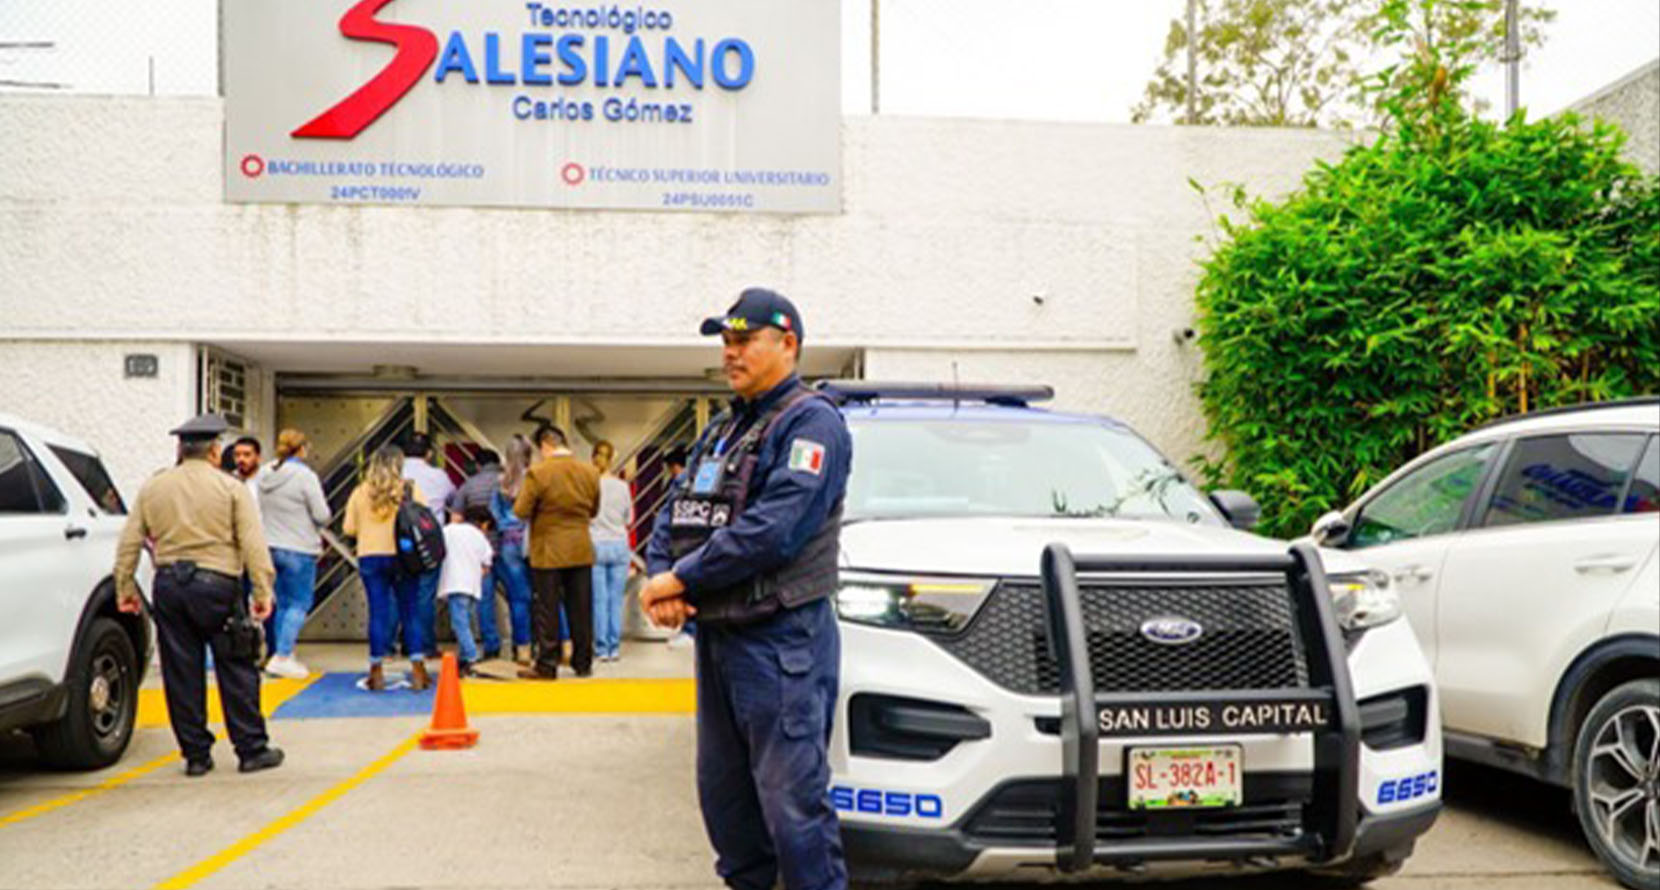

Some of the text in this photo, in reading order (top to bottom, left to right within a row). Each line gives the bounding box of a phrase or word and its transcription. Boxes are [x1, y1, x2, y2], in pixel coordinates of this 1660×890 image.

[527, 3, 673, 33] Tecnológico
[513, 97, 693, 123] Carlos Gómez
[267, 160, 484, 178] BACHILLERATO TECNOLÓGICO
[589, 167, 830, 187] TÉCNICO SUPERIOR UNIVERSITARIO
[1099, 704, 1328, 730] SAN LUIS CAPITAL
[1135, 761, 1236, 790] SL-382A-1
[1377, 770, 1438, 805] 6650
